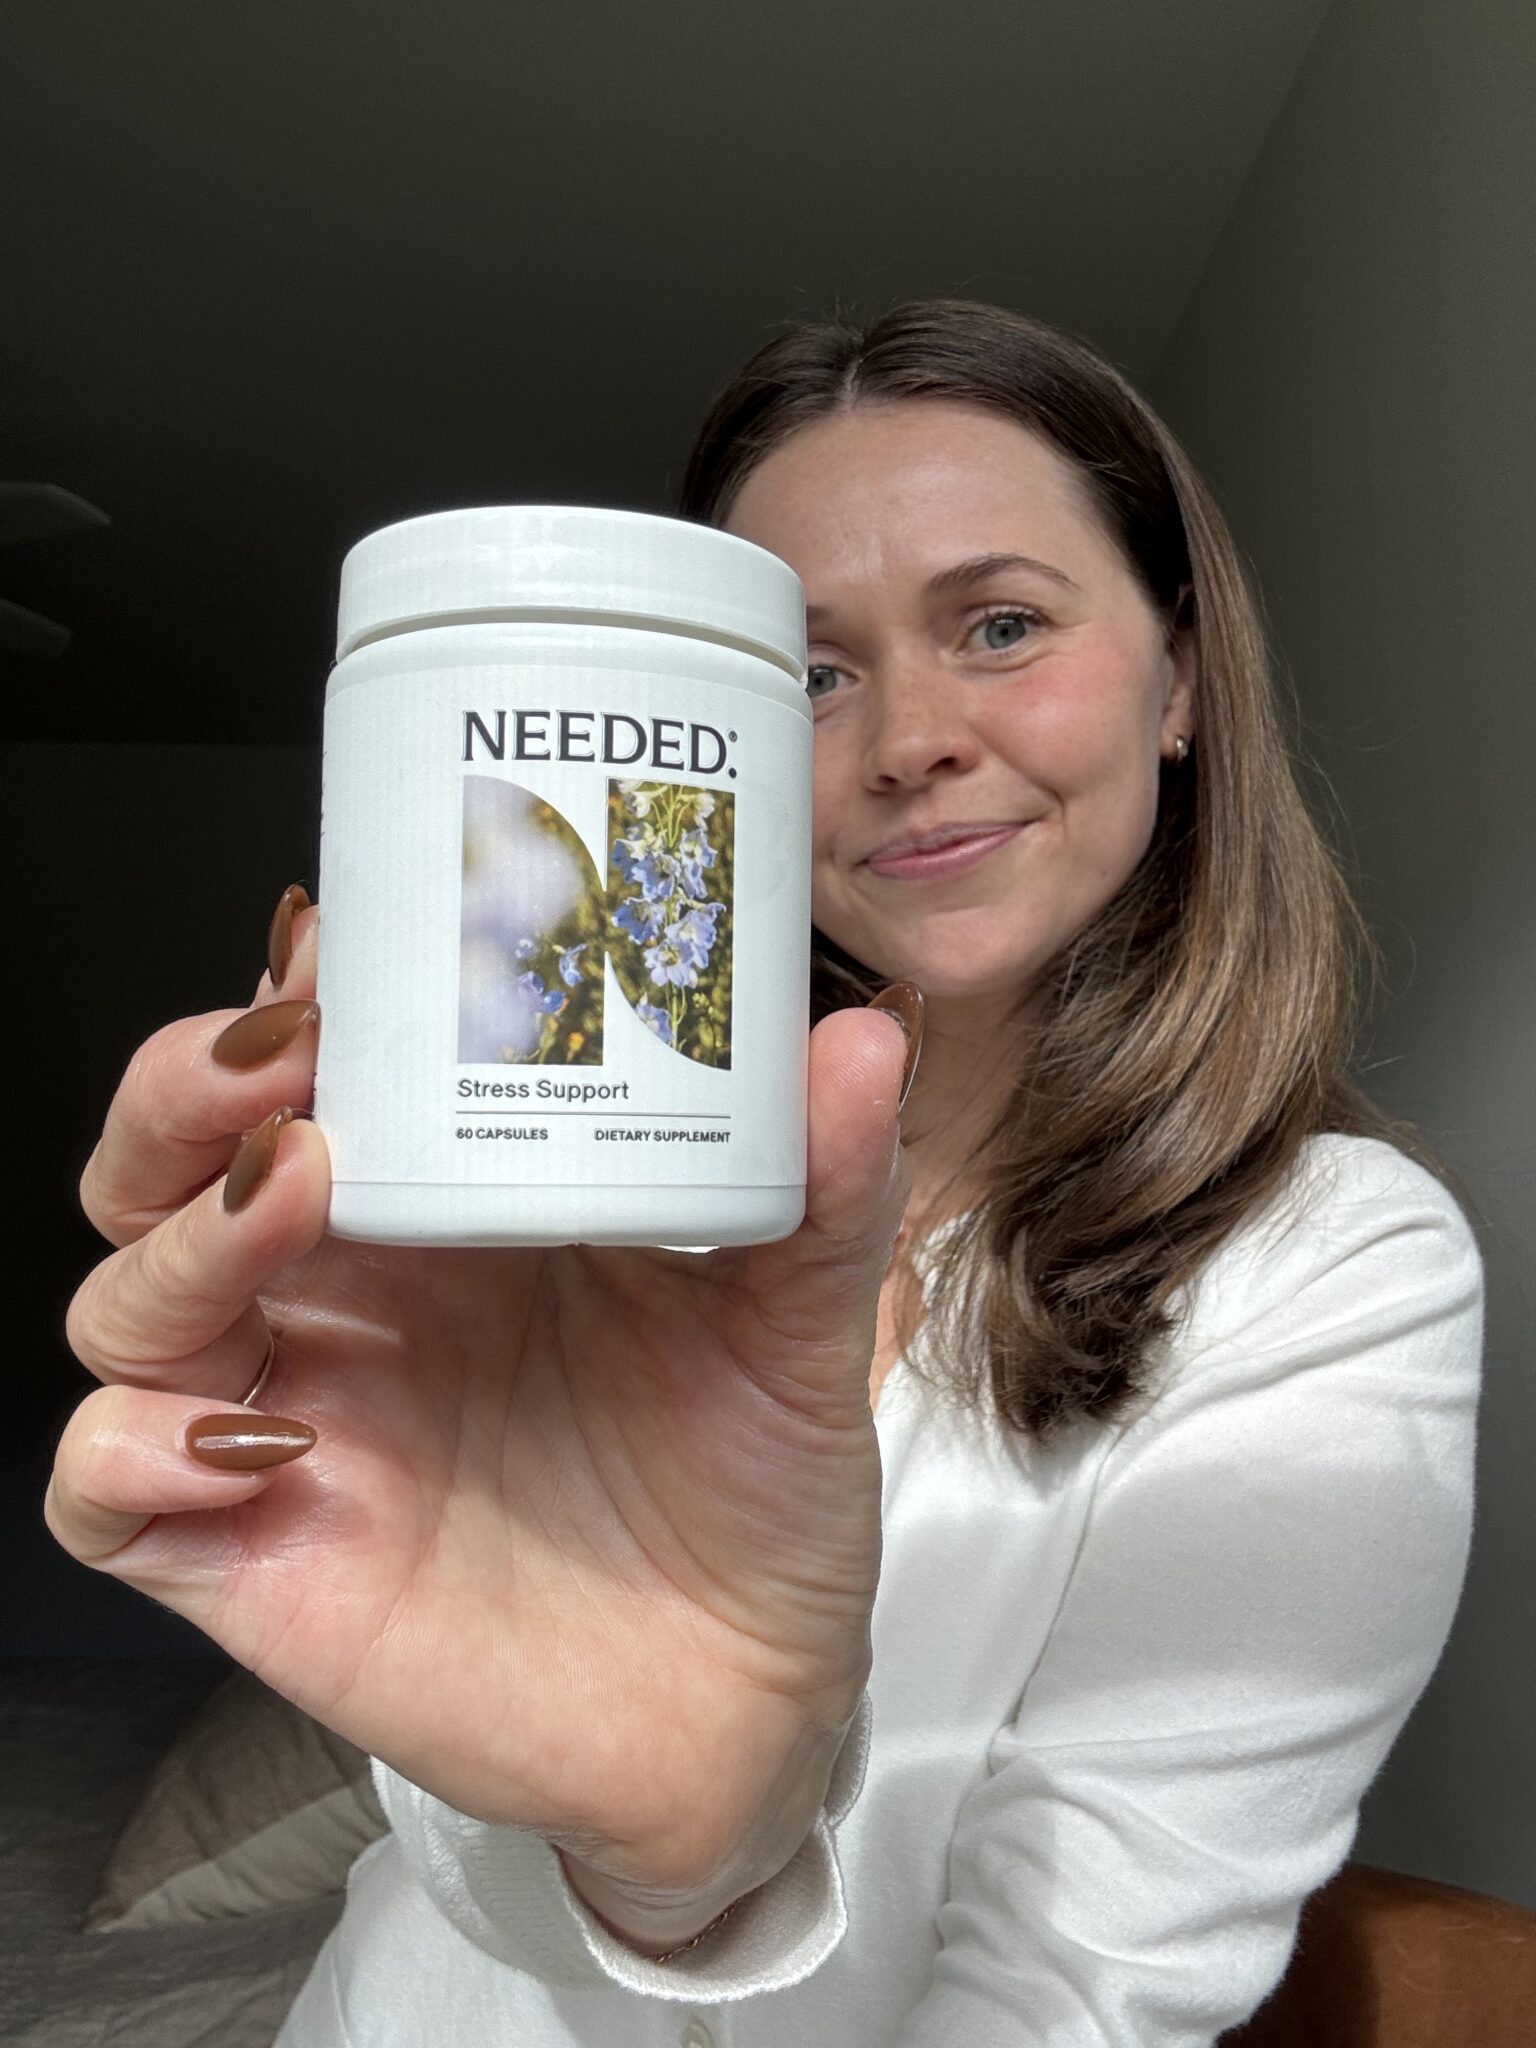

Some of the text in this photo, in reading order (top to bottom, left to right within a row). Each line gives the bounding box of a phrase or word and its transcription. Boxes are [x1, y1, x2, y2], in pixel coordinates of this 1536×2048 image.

[457, 1079, 629, 1103] Stress Support
[456, 1128, 549, 1141] 60 CAPSULES
[595, 1129, 731, 1143] DIETARY SUPPLEMENT
